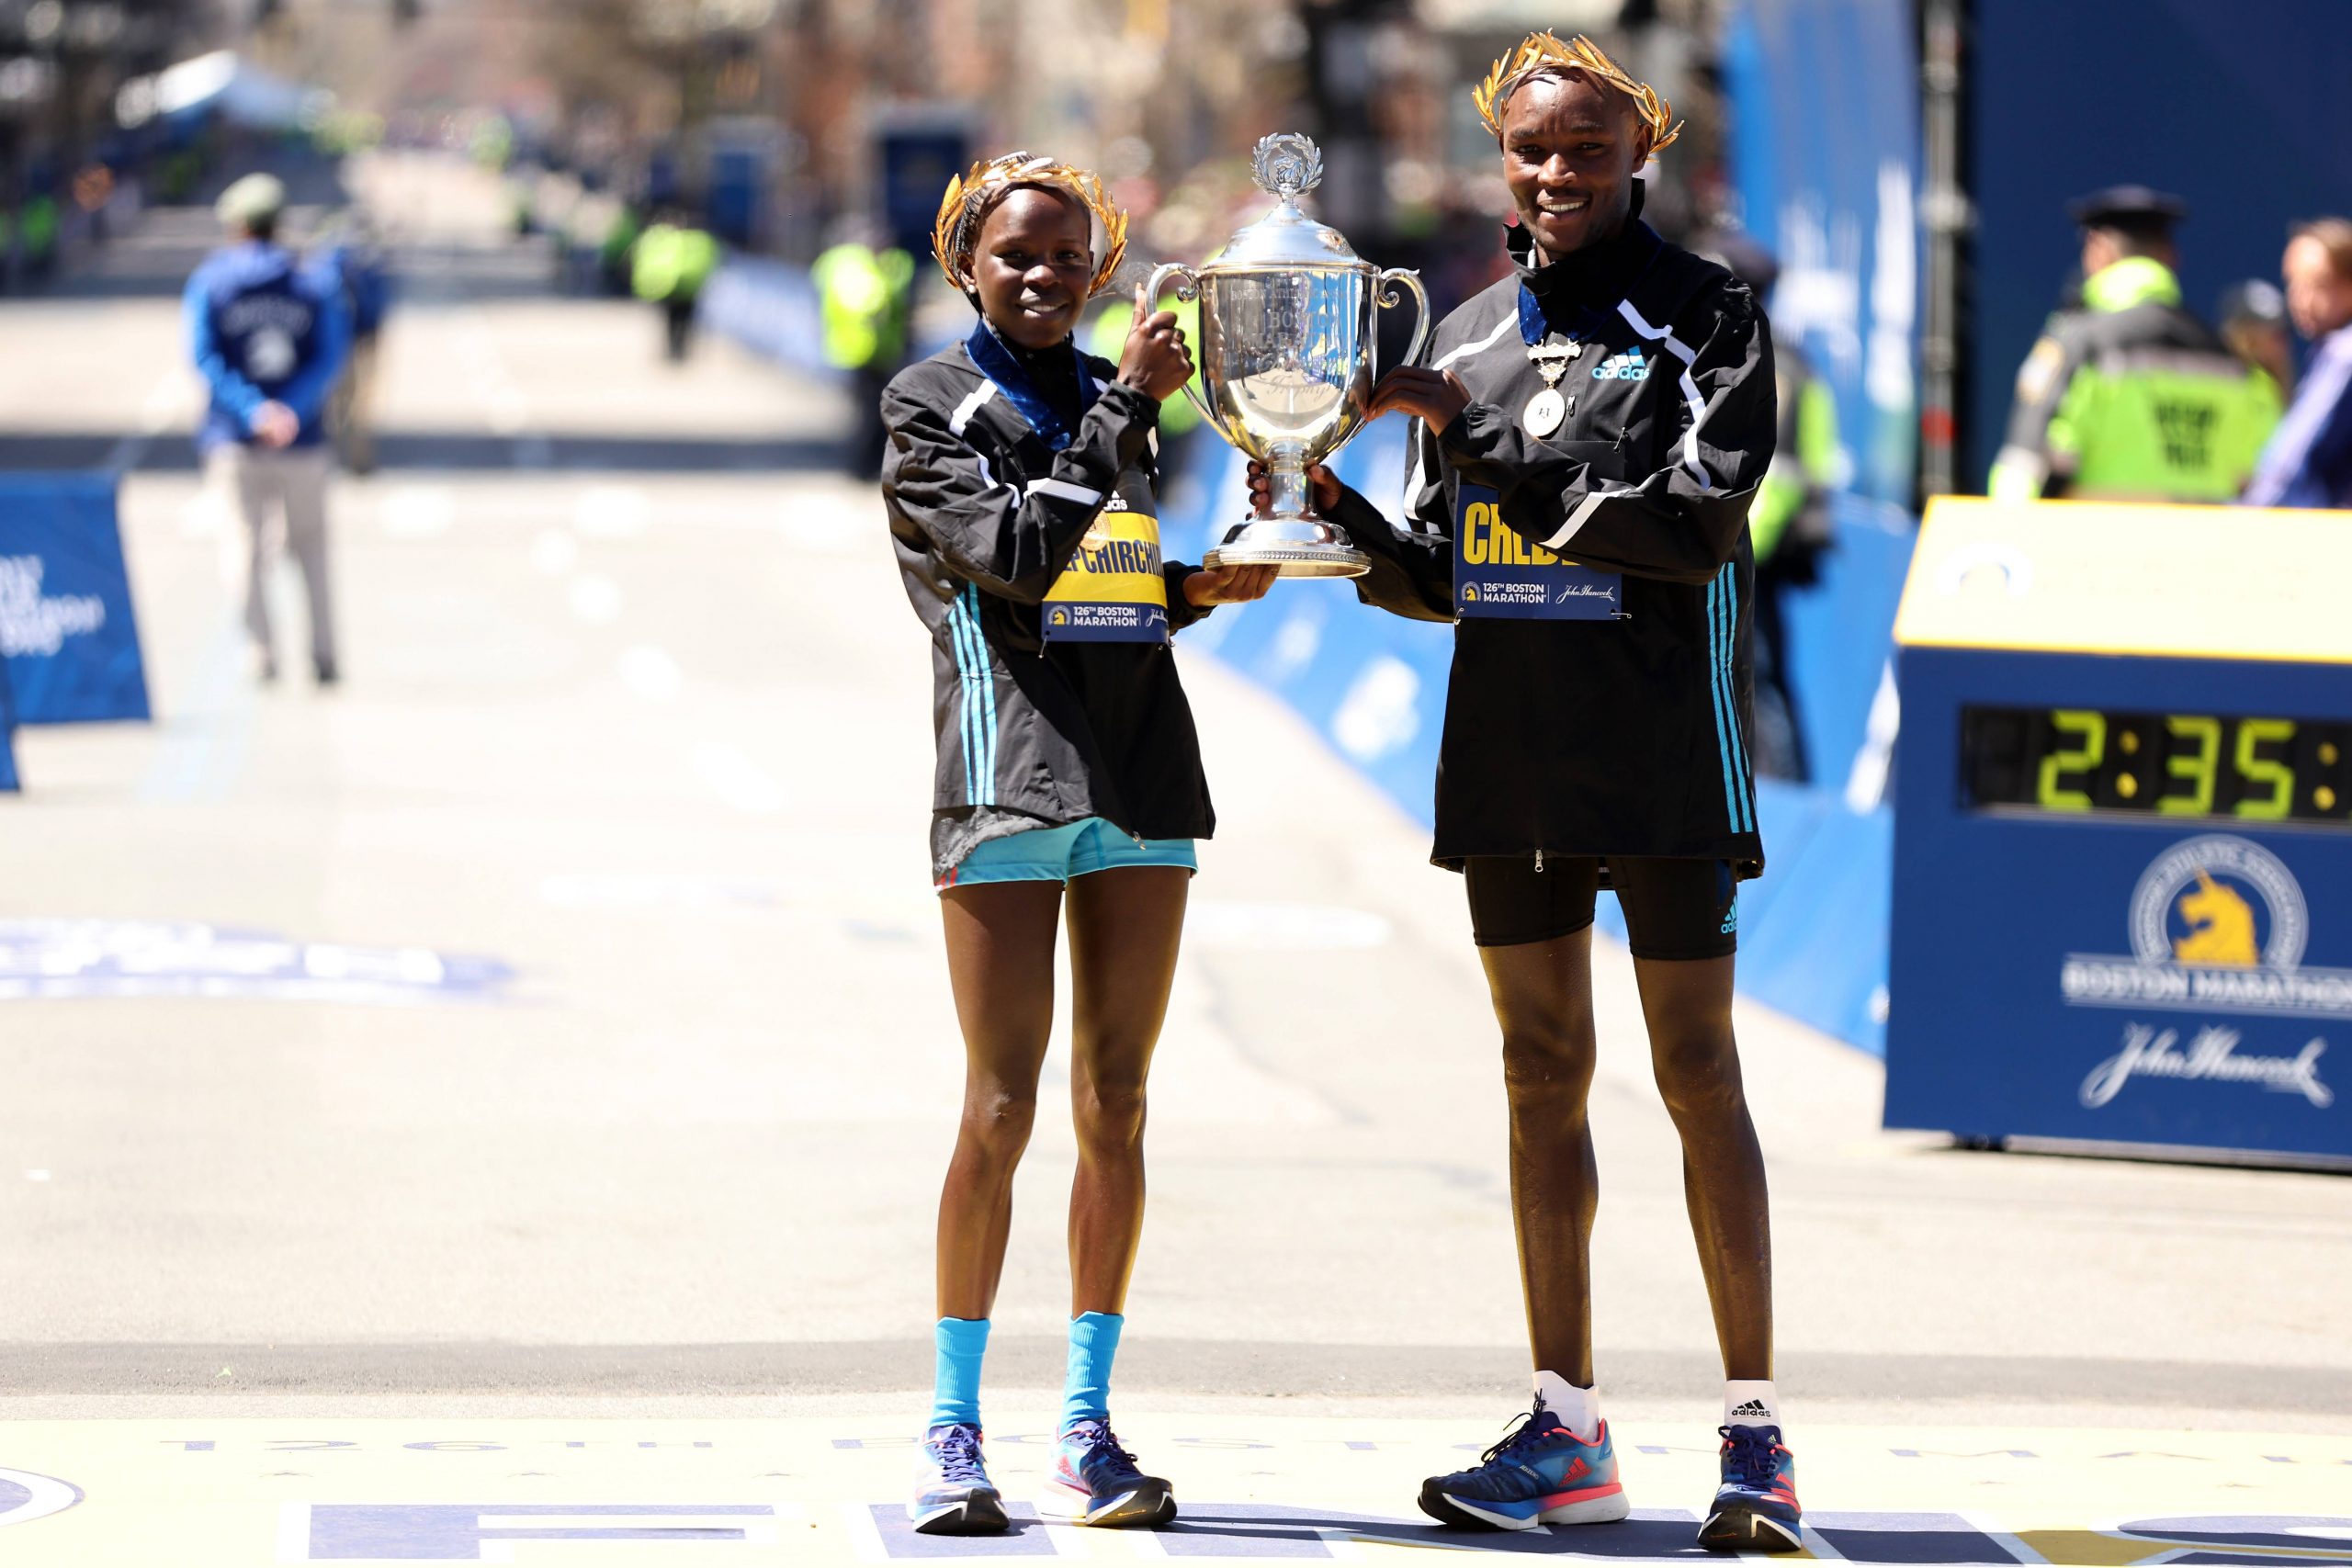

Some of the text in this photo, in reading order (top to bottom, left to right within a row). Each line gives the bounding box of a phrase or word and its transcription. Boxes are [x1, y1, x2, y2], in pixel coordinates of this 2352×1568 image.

[1591, 364, 1650, 381] adidas
[1506, 583, 1544, 593] BOSTON
[1483, 593, 1545, 604] MARATHON
[1097, 606, 1136, 617] BOSTON
[1074, 616, 1138, 626] MARATHON
[2061, 961, 2190, 1001] BOSTON
[1732, 1407, 1770, 1417] adidas
